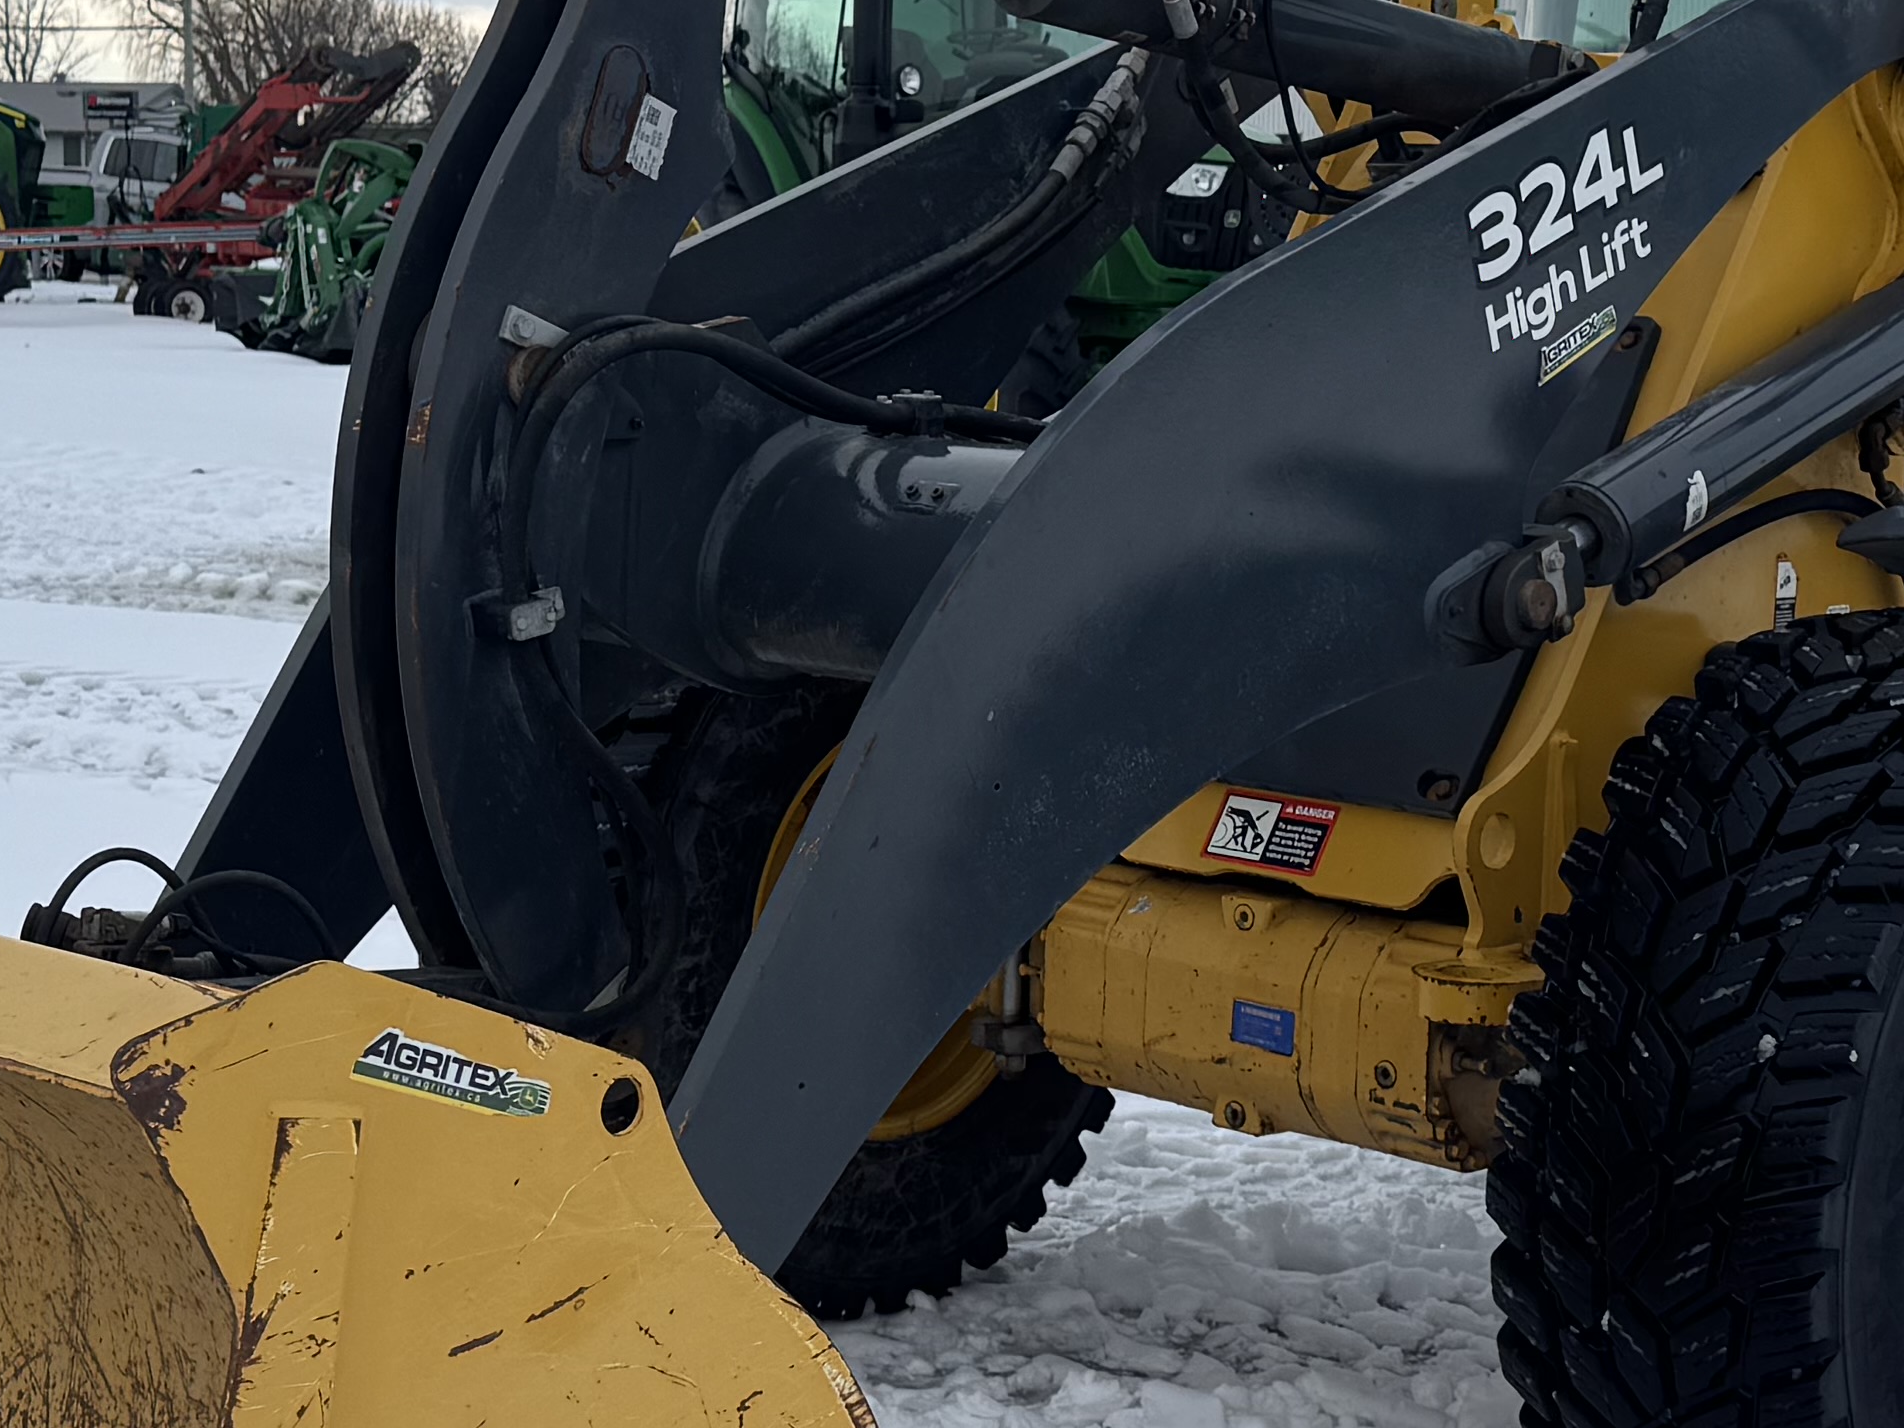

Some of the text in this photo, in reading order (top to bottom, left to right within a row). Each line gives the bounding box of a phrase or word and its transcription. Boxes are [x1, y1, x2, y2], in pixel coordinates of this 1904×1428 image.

[1468, 126, 1664, 282] 324L
[1485, 217, 1652, 352] High Lift
[360, 1031, 515, 1098] AGRITEX
[382, 1071, 482, 1104] www.agritex.ca
